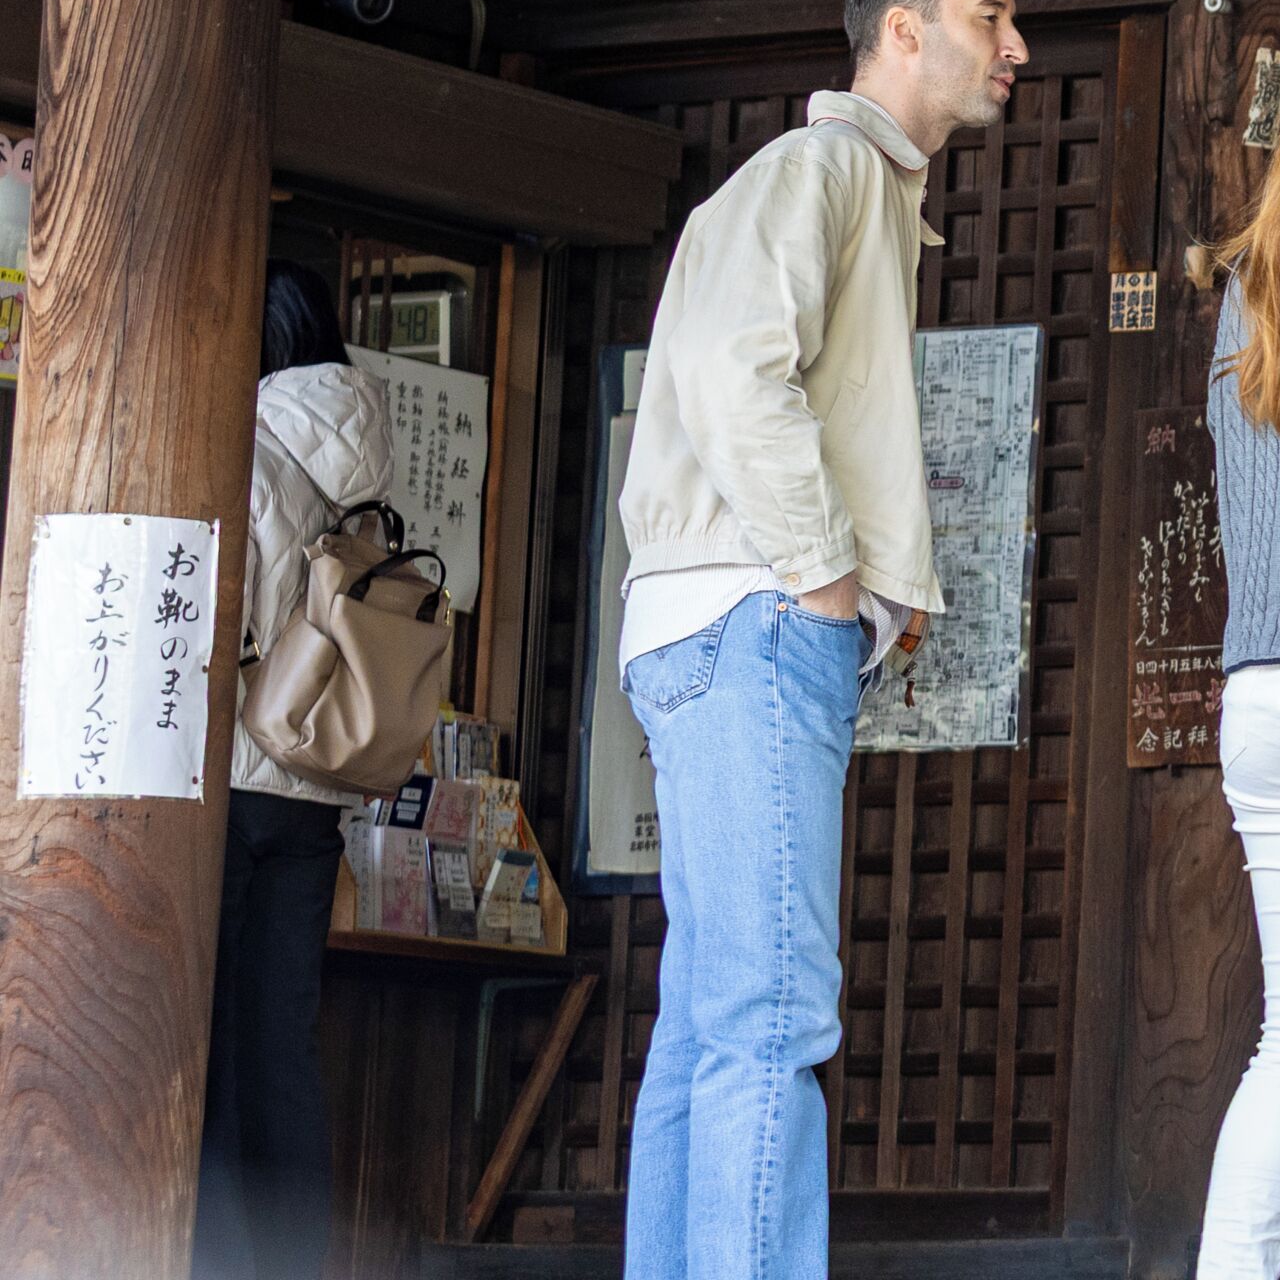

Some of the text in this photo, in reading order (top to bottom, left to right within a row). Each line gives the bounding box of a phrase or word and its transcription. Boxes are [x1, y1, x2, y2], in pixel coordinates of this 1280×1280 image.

[75, 560, 129, 790] お上がりください
[154, 541, 200, 730] お靴のまま
